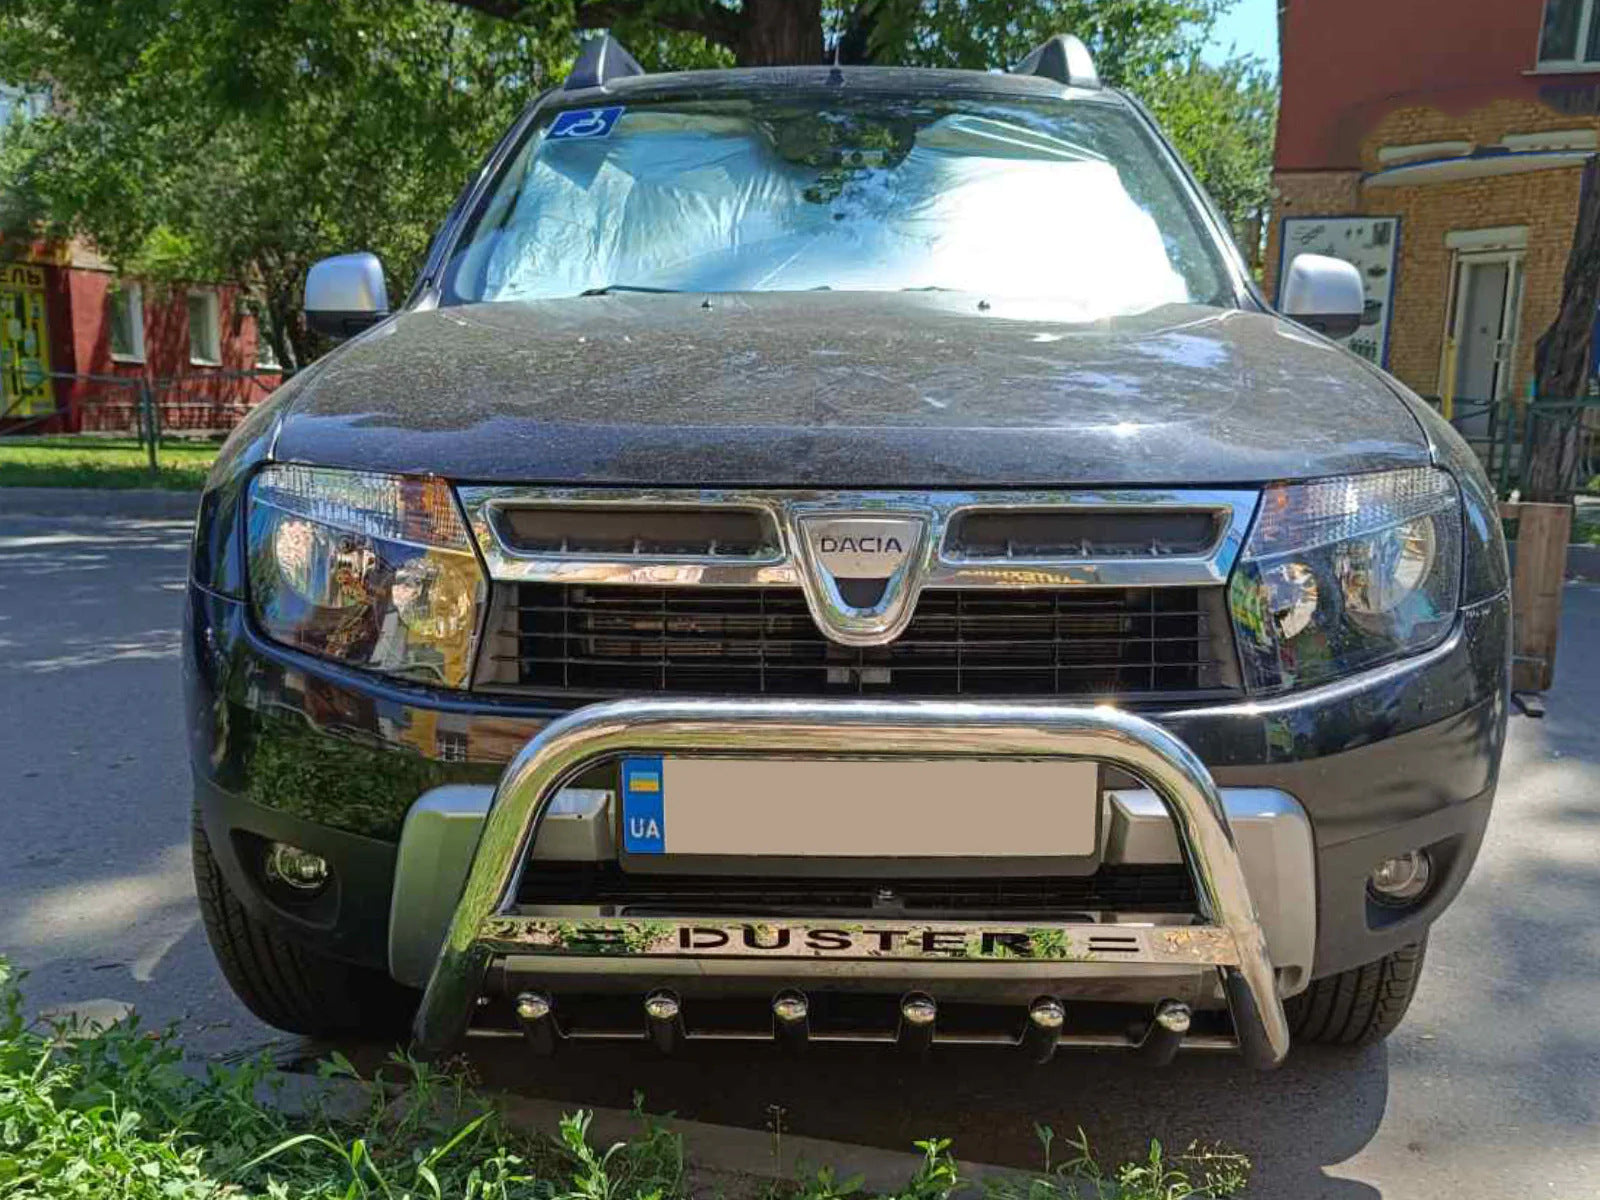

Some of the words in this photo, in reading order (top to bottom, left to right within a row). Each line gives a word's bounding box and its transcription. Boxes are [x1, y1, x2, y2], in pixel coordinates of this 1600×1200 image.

[821, 537, 903, 553] DACIA
[630, 818, 661, 838] UA
[679, 926, 1032, 956] DUSTER
